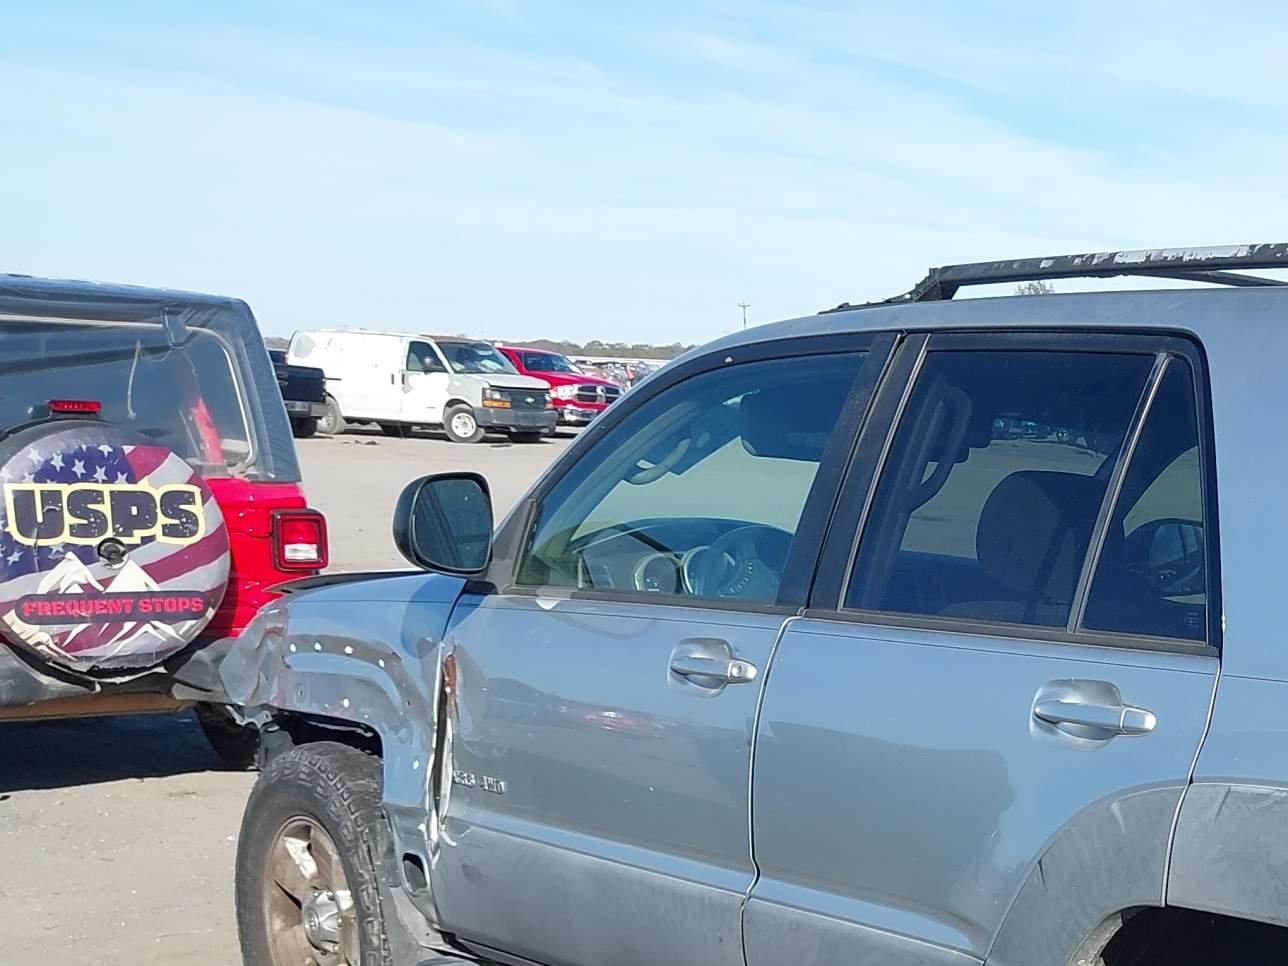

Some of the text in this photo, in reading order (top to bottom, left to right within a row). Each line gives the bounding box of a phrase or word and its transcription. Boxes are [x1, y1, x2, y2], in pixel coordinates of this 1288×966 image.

[8, 486, 203, 542] USPS
[22, 597, 204, 617] FREQUENT STOPS
